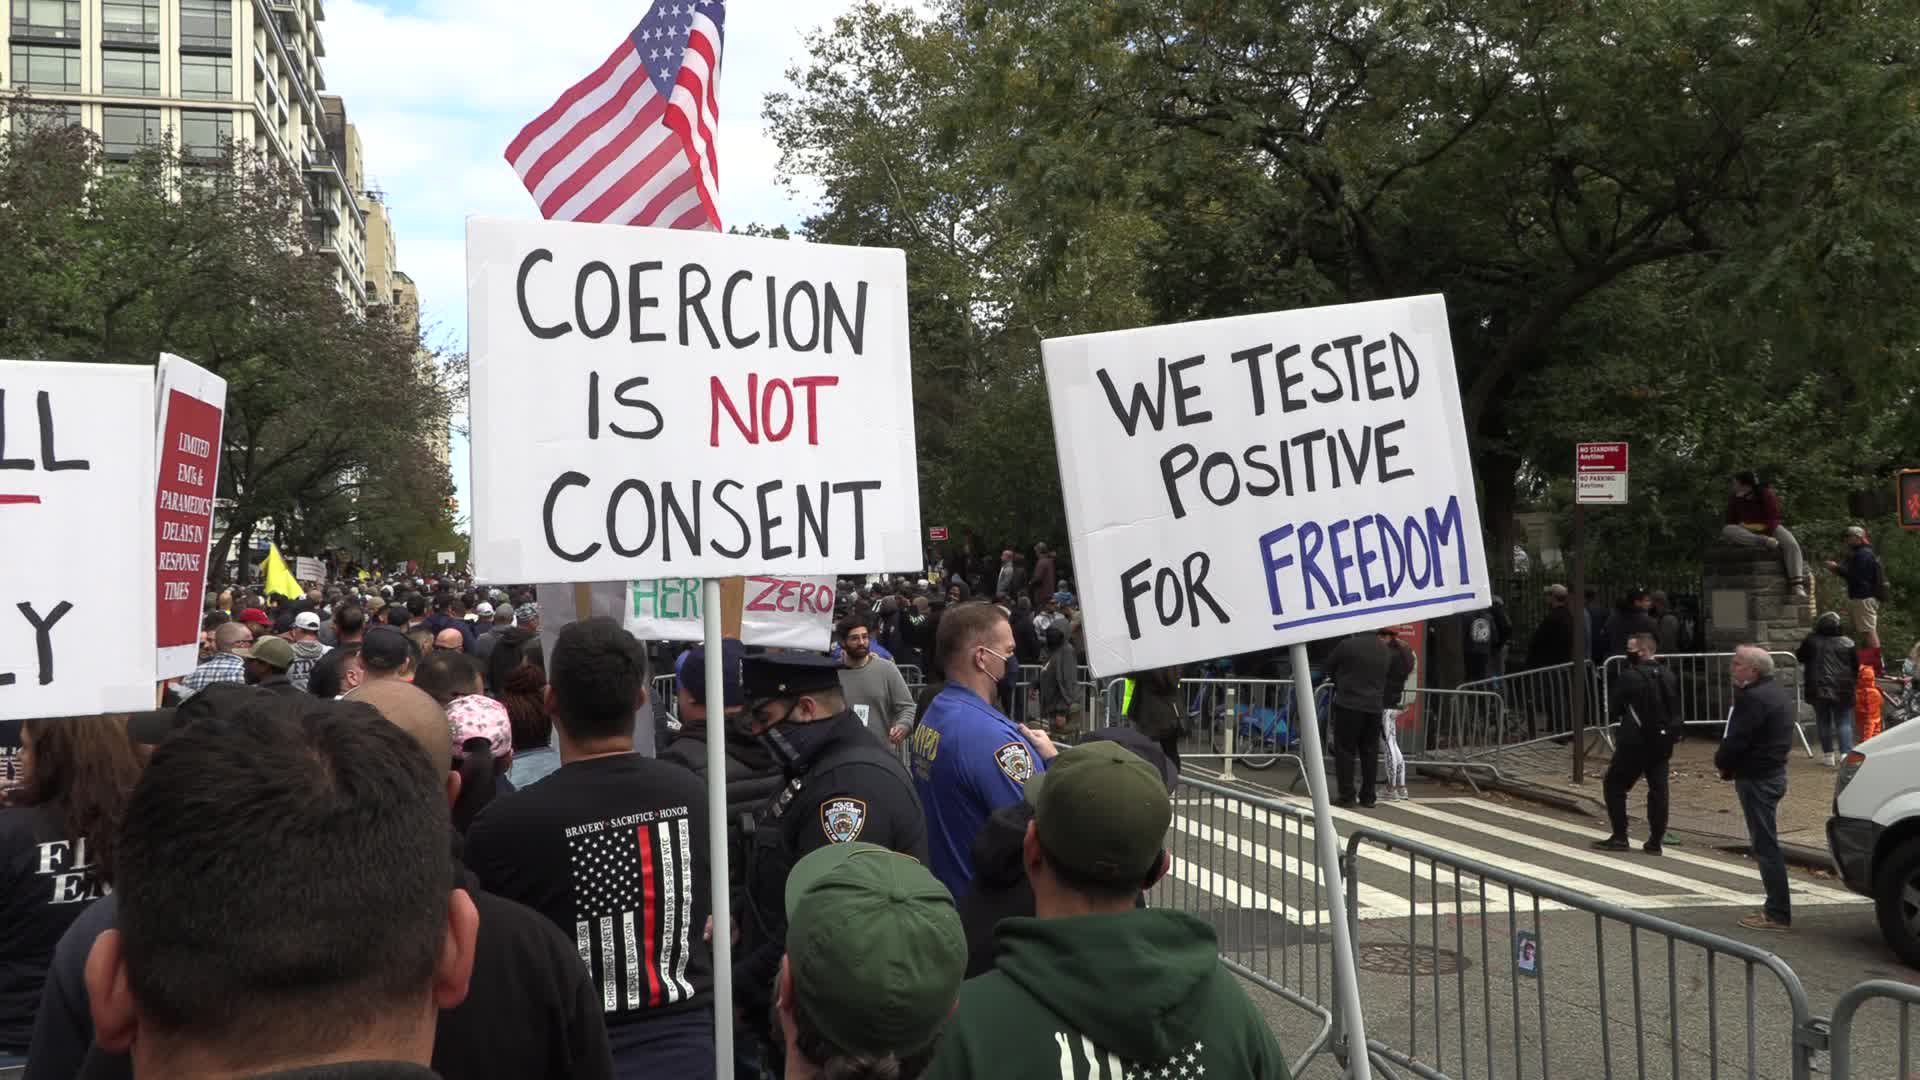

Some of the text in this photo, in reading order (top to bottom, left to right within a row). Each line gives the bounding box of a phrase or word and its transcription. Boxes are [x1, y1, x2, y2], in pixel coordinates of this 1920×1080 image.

[517, 249, 868, 355] COERCION
[1096, 332, 1419, 436] WE TESTED
[589, 371, 838, 447] IS NOT
[178, 432, 210, 458] LIMITED
[1160, 419, 1414, 519] POSITIVE
[160, 490, 211, 516] PARAMEDICS
[543, 471, 881, 562] CONSENT
[162, 521, 203, 543] DELAYS IN
[159, 552, 200, 571] RESPONSE
[1121, 496, 1469, 640] FOR FREEDOM
[164, 582, 190, 600] TIMES
[634, 576, 833, 619] HER ZERO
[565, 806, 688, 838] BRAVERY SACRIFICE HONOR
[661, 838, 670, 856] WTC
[624, 922, 637, 964] DAVIDSON
